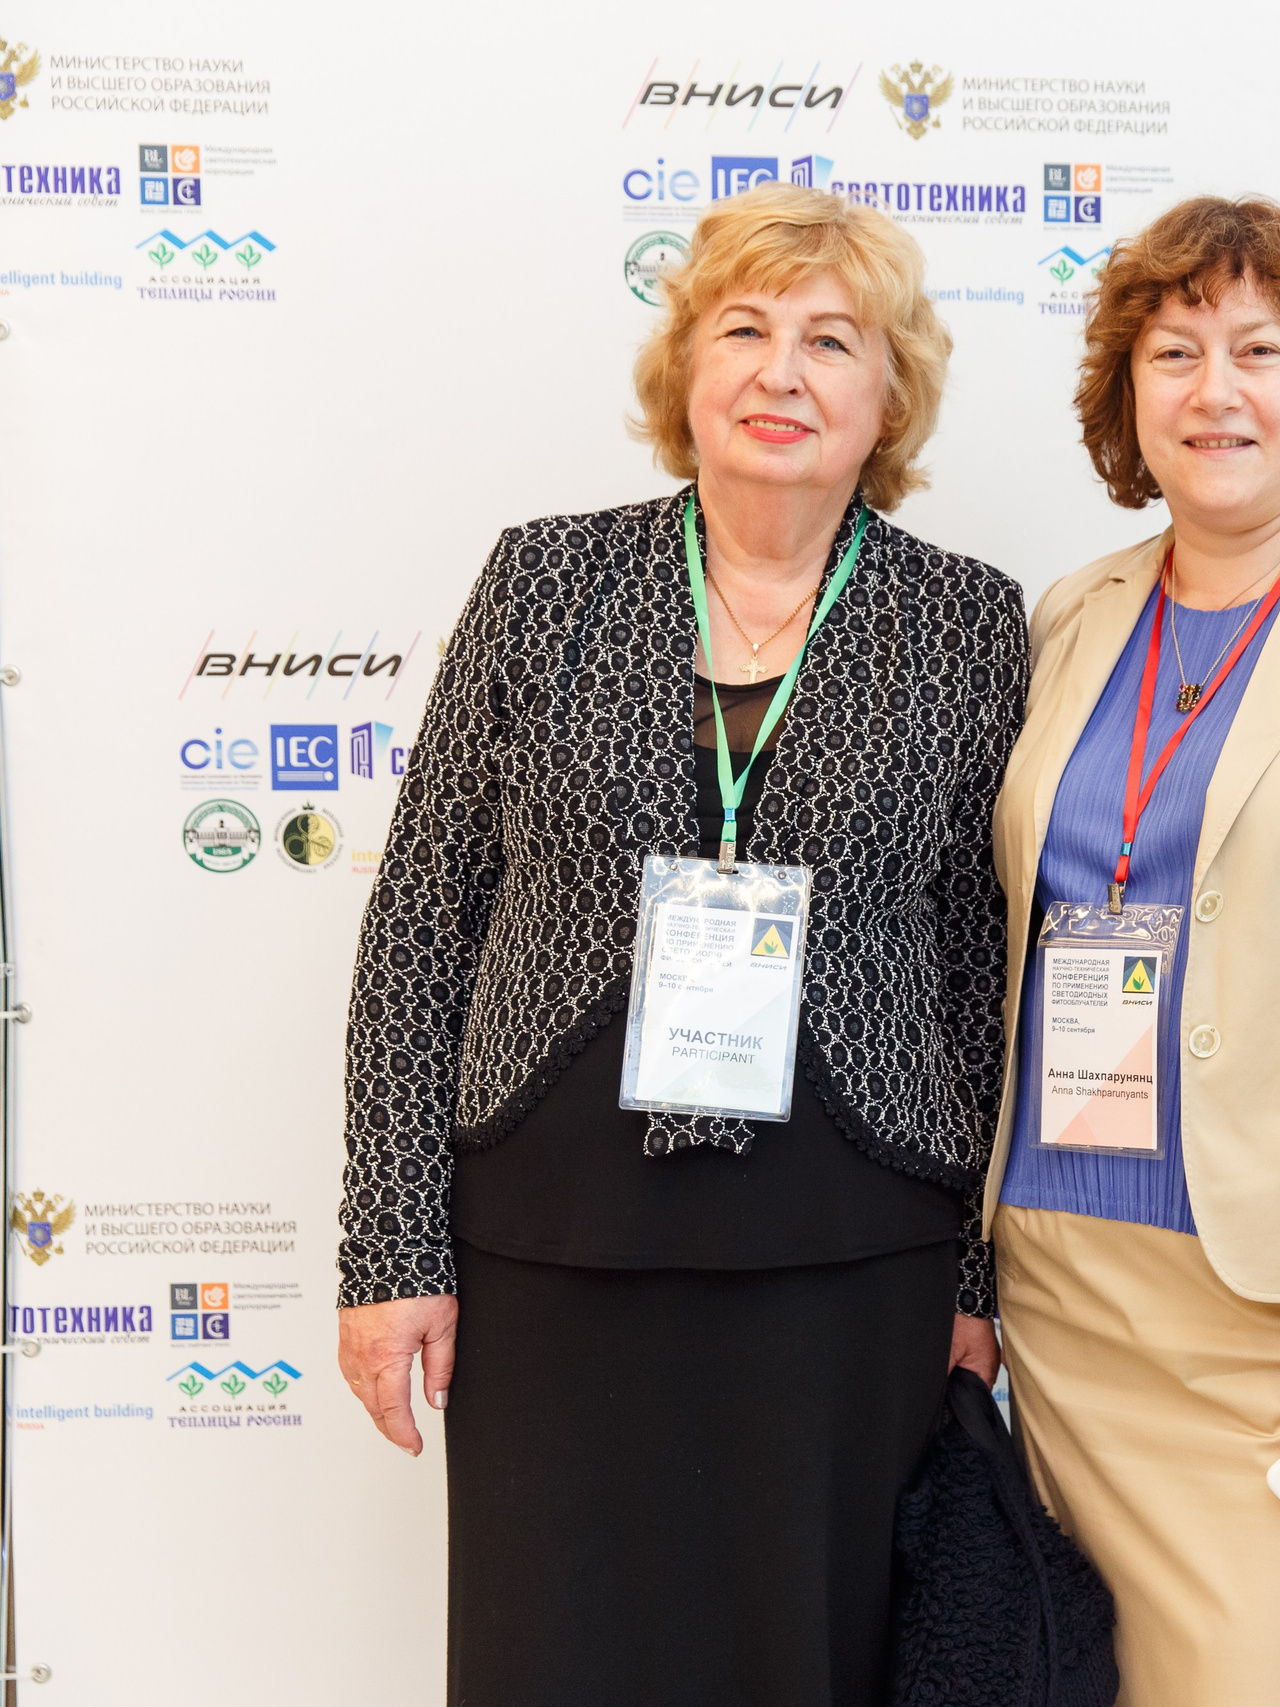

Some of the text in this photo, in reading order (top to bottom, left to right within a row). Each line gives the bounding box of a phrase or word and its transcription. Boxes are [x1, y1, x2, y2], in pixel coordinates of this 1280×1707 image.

[50, 55, 244, 73] МИНИСТЕРСТВО НАУКИ
[50, 76, 271, 94] И ВЫСШЕГО ОБРАЗОВАНИЯ
[962, 77, 1146, 95] МИНИСТЕРСТВО НАУКИ
[640, 81, 844, 109] ВНИСИ
[51, 94, 269, 115] РОССИЙСКОЙ ФЕДЕРАЦИИ
[962, 97, 1171, 115] И ВЫСШЕГО ОБРАЗОВАНИЯ
[962, 114, 1168, 136] РОССИЙСКОЙ ФЕДЕРАЦИИ
[623, 157, 700, 201] cie
[61, 271, 122, 289] building
[149, 275, 261, 285] АССОЦИАЦИЯ
[137, 287, 276, 302] ТЕПЛИЦЫ РОССИИ
[966, 286, 1024, 304] building
[196, 653, 402, 677] ВНИСИ
[181, 727, 259, 770] cie
[276, 736, 334, 768] IEC
[750, 962, 787, 971] ВНИСИ
[1053, 958, 1110, 966] МЕЖДУНАРОДНАЯ
[1052, 973, 1109, 981] КОНФЕРЕНЦИЯ
[678, 984, 714, 993] снтября
[1051, 990, 1108, 999] СВЕТОДИОДНЫХ
[1062, 982, 1109, 990] ПРИМЕНЕНИЮ
[1051, 999, 1108, 1007] ФИТООБЛУЧАТЕЛЕЙ
[1051, 1017, 1080, 1025] МОСКВА,
[668, 1027, 764, 1050] УЧАСТНИК
[1066, 1026, 1096, 1034] сентября
[671, 1046, 756, 1064] PARTICIPANT
[1048, 1067, 1154, 1084] Анна Шахпарунянц
[1051, 1085, 1149, 1100] Anna Shakhparunyants
[84, 1202, 271, 1217] МИНИСТЕРСТВО НАУКИ
[85, 1220, 297, 1237] И ВЫСШЕГО ОБРАЗОВАНИЯ
[86, 1238, 296, 1256] РОССИЙСКОЙ ФЕДЕРАЦИИ
[16, 1403, 153, 1421] intelligent building
[179, 1403, 287, 1413] АССОЦИАЦИЯ
[168, 1415, 302, 1429] ТЕПЛИЦЫ РОССИИ
